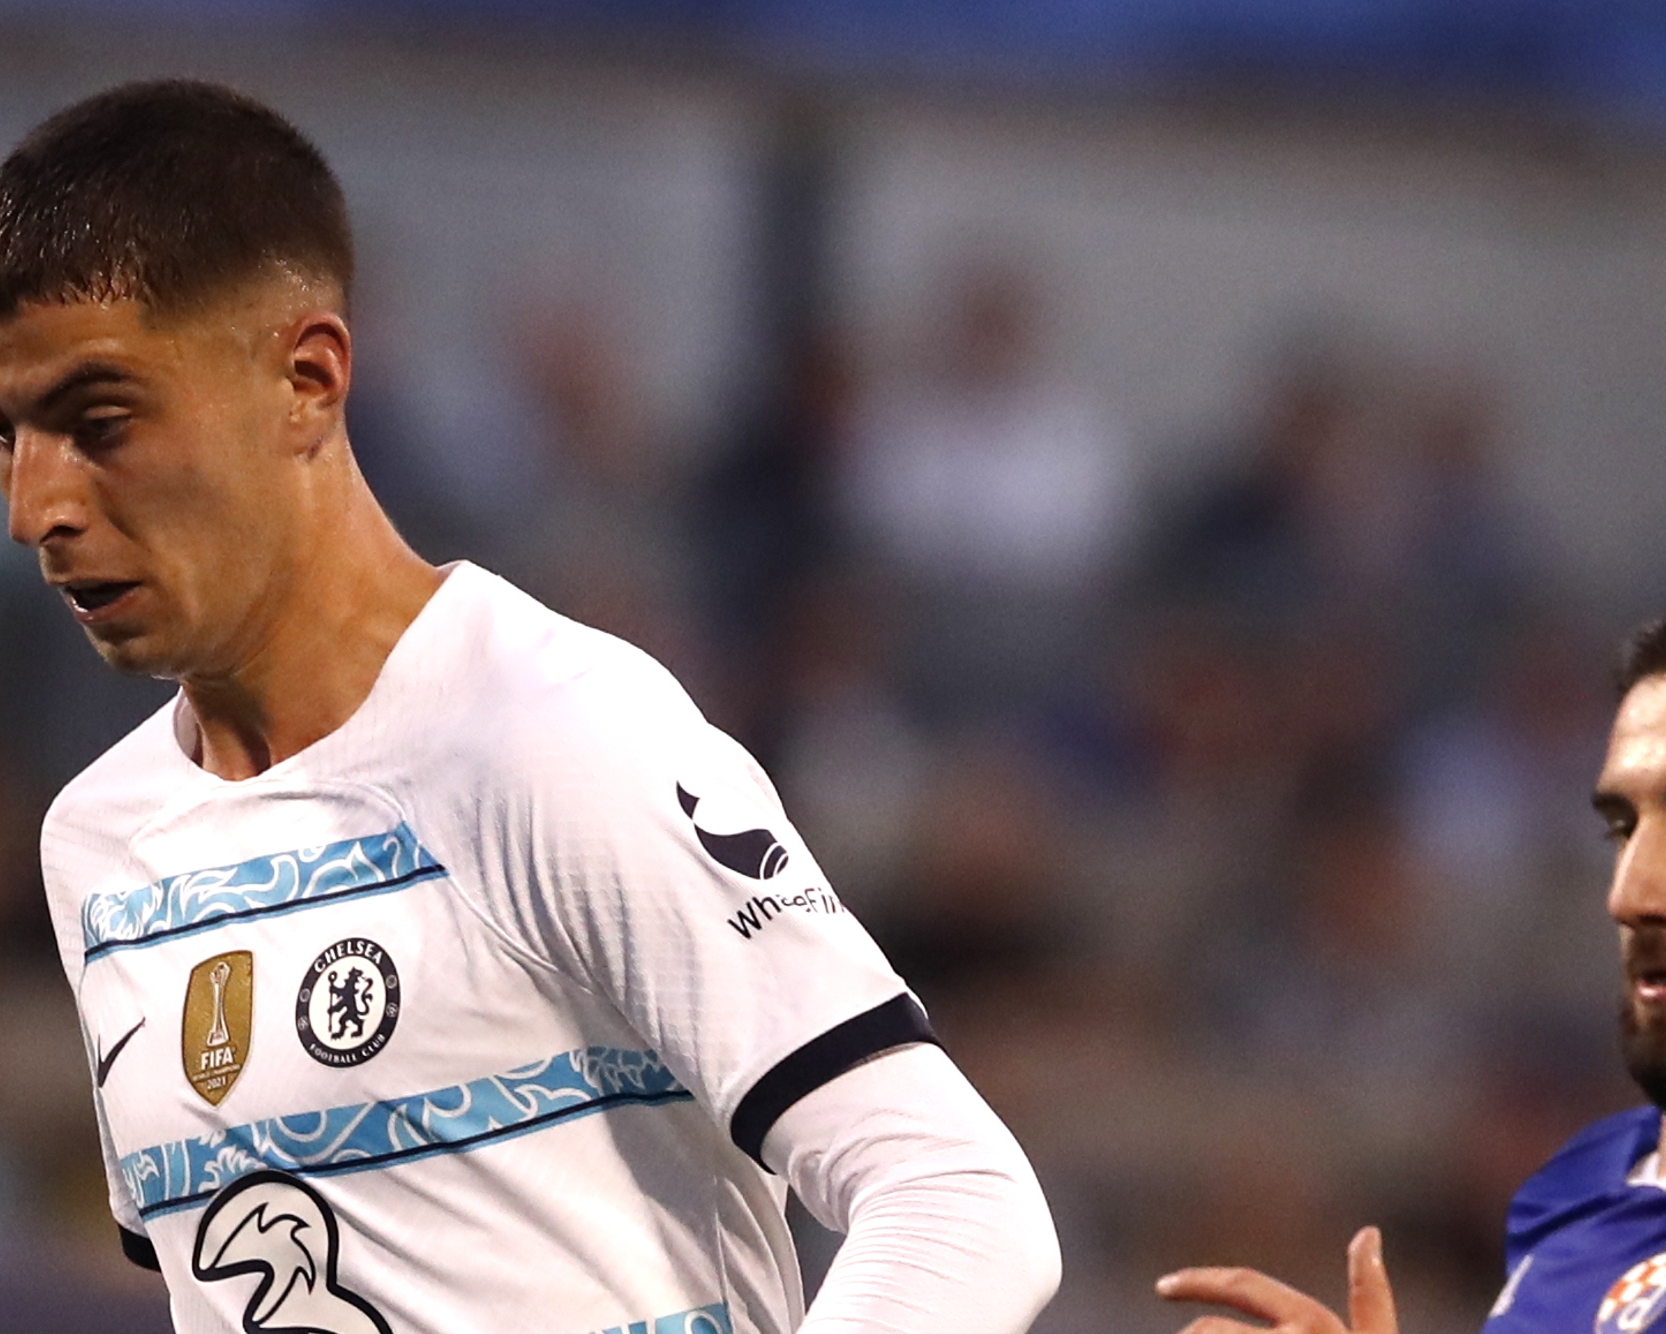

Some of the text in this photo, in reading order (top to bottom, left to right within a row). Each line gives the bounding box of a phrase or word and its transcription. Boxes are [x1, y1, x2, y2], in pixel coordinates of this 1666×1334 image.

[314, 940, 383, 973] CHELSEA
[201, 1046, 233, 1070] FIFA
[309, 1033, 386, 1065] FOOTBALL CLUB
